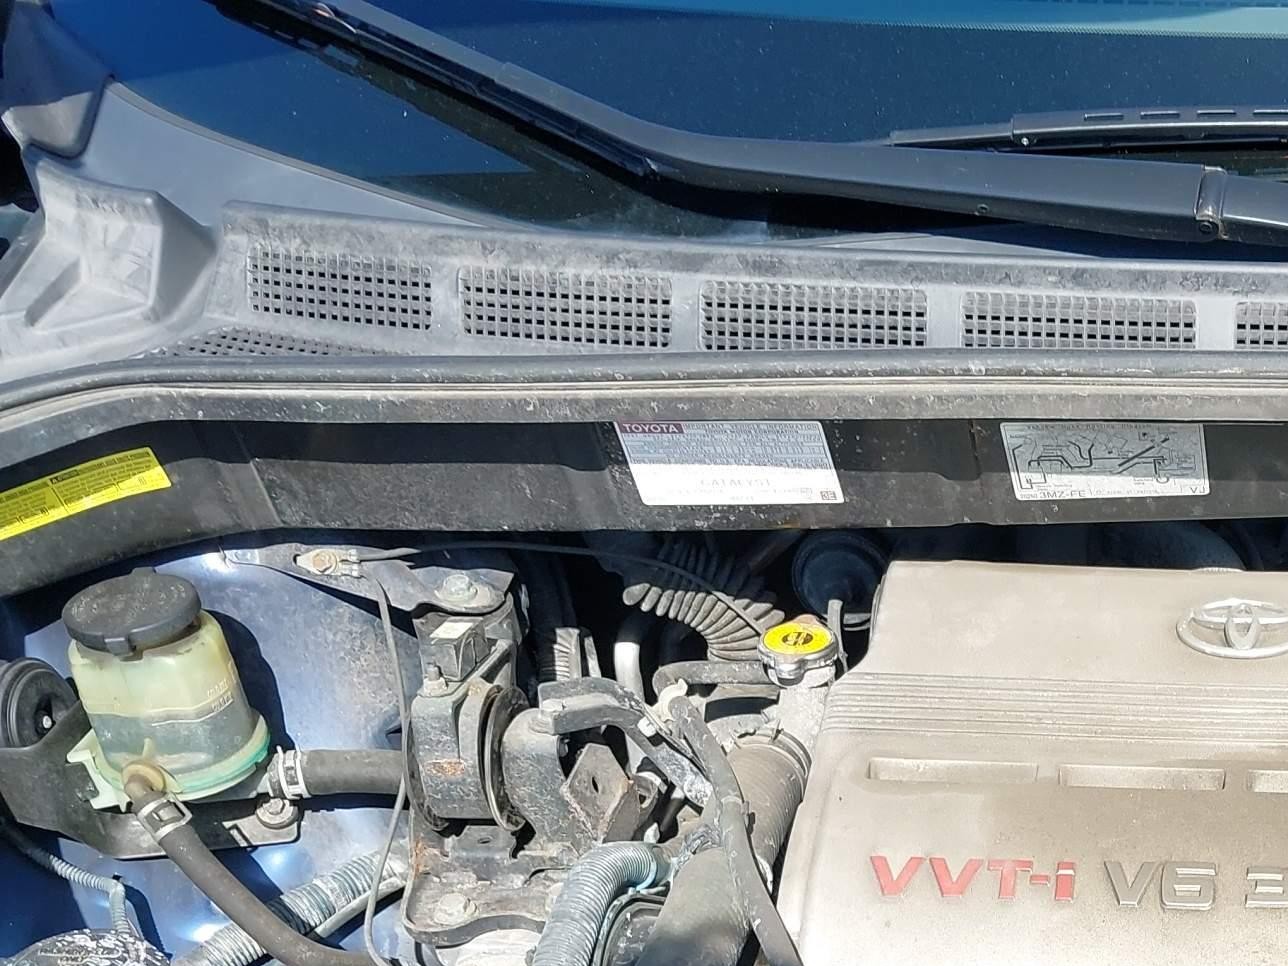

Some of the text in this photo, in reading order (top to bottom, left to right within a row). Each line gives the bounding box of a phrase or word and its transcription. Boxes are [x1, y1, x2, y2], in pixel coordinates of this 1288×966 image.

[622, 423, 679, 433] TOYOTA
[1039, 489, 1088, 499] 3MZ-FE
[870, 856, 1077, 901] VVT-i
[1103, 860, 1217, 911] V6
